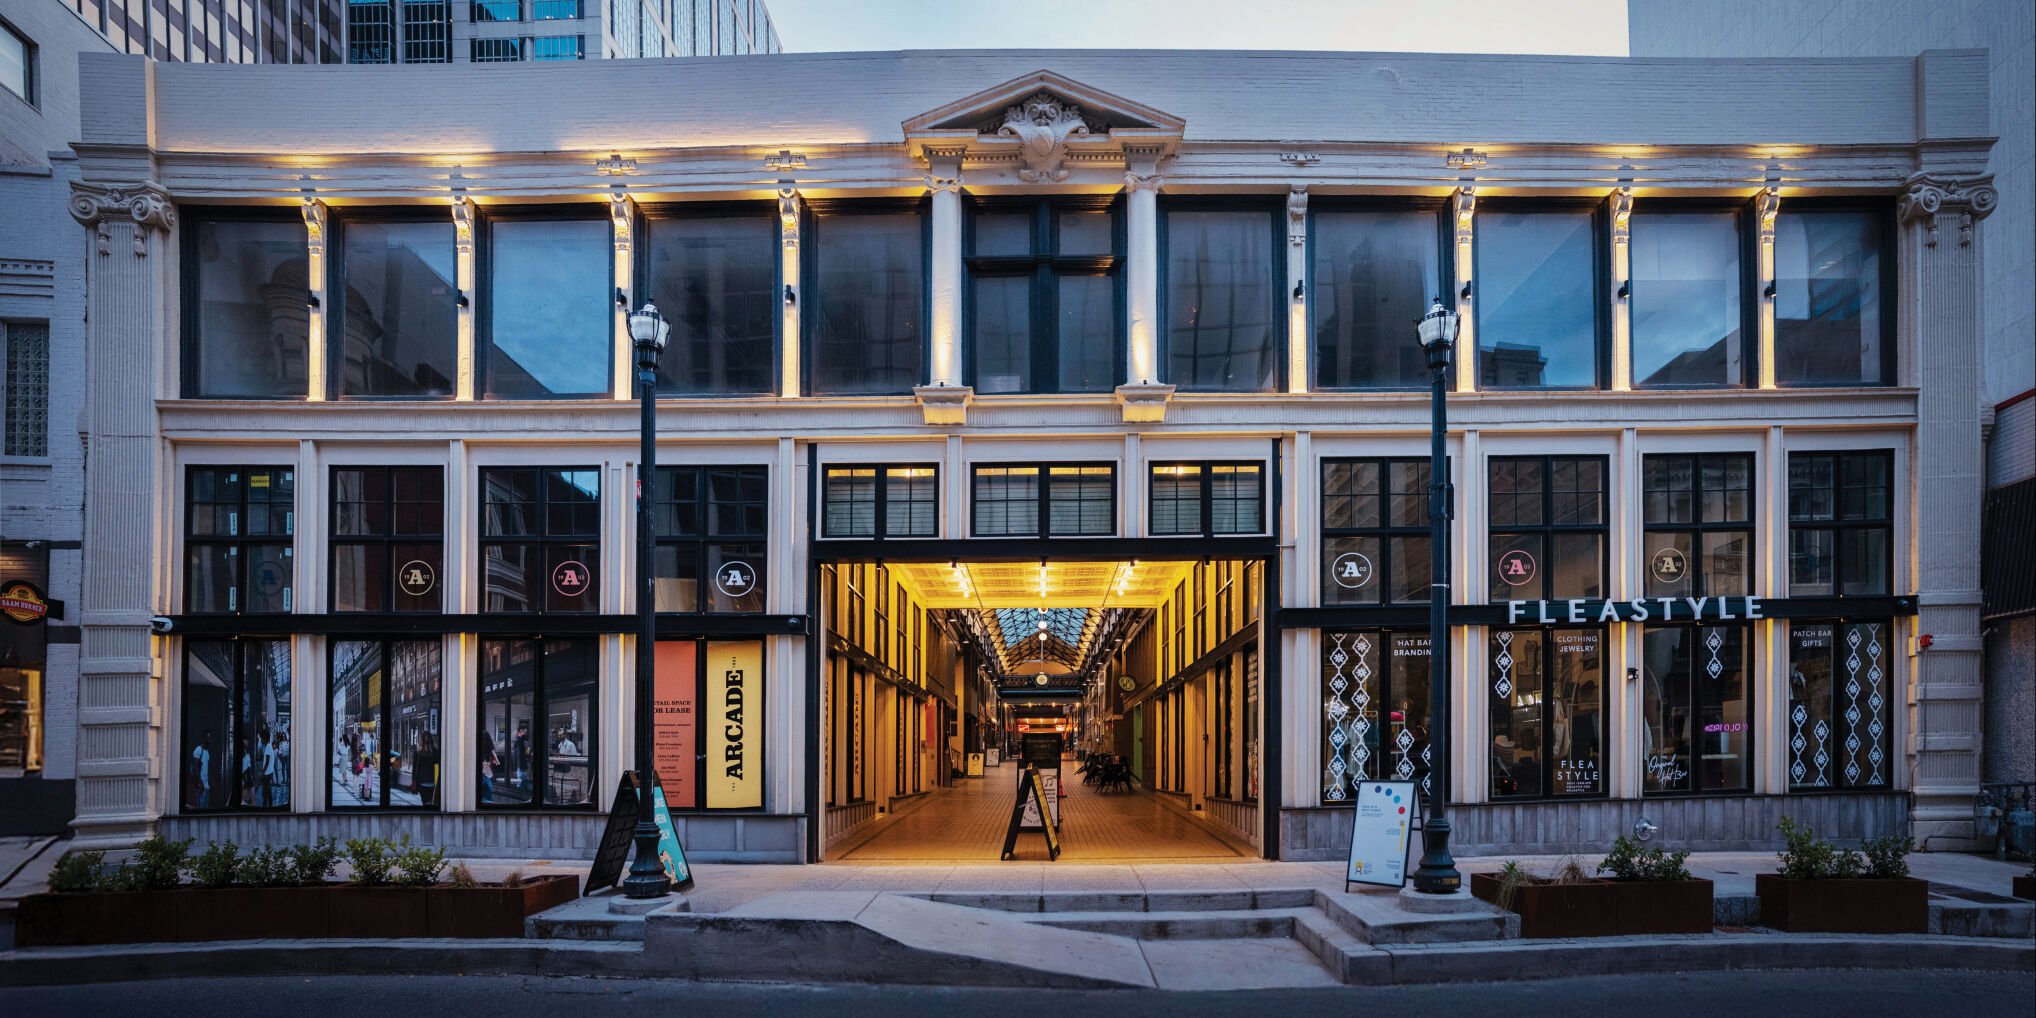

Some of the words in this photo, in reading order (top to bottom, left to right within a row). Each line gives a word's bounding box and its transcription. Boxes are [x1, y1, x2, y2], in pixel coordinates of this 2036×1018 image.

[1341, 561, 1361, 577] A
[1507, 559, 1526, 575] A
[1660, 557, 1678, 572] A
[407, 569, 425, 584] A
[561, 570, 580, 585] A
[725, 570, 745, 585] A
[1508, 595, 1764, 625] FLEASTYLE
[1557, 635, 1598, 643] CLOTHING
[1793, 630, 1816, 638] PATCH
[1398, 639, 1415, 647] HAT
[1559, 644, 1594, 652] JEWELRY
[725, 670, 744, 780] ARCADE
[1561, 760, 1594, 769] FLEA
[1557, 771, 1599, 780] STYLE
